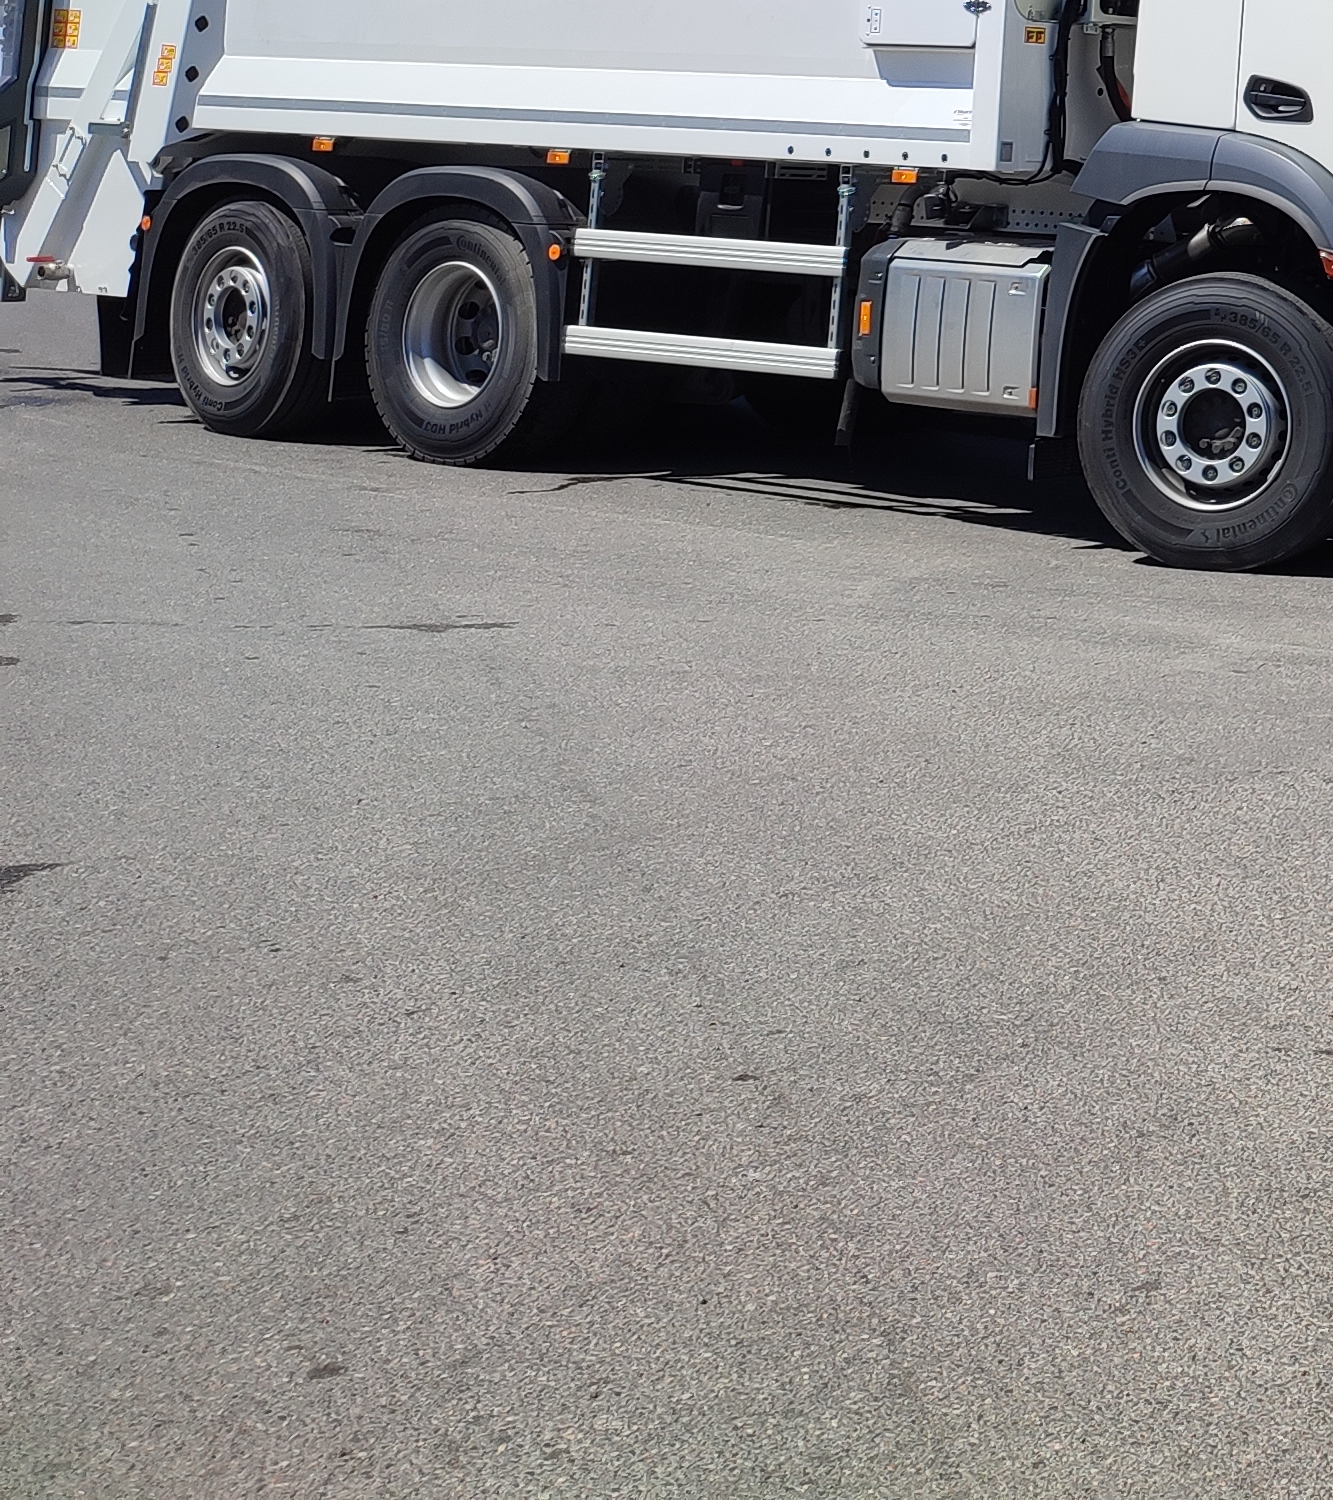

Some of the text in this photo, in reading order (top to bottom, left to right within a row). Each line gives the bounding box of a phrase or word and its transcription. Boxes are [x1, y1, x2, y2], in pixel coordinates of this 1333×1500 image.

[218, 221, 224, 232] R
[456, 234, 507, 287] Continental
[1227, 310, 1281, 345] 385/65
[1101, 383, 1120, 441] Hybrid
[1103, 447, 1128, 492] Conti
[1216, 482, 1299, 542] Continental
